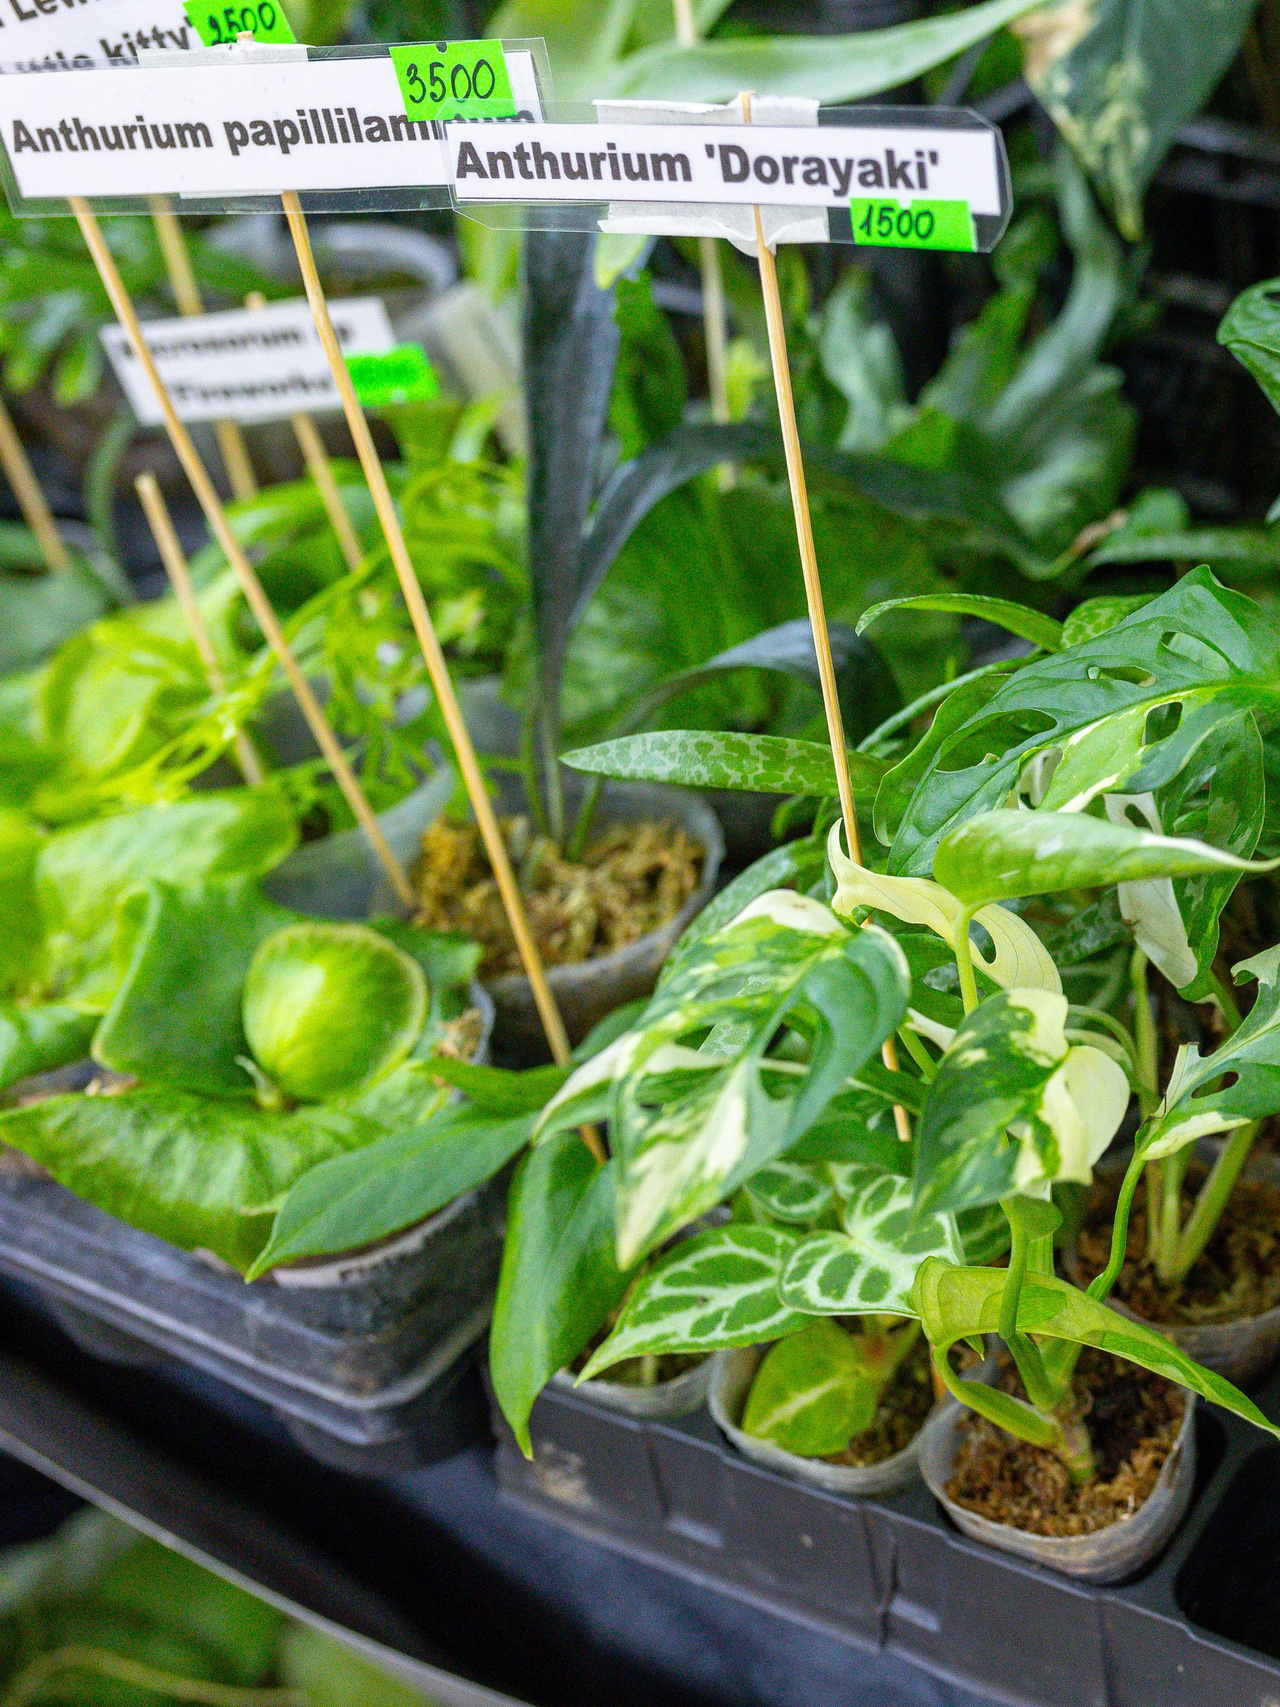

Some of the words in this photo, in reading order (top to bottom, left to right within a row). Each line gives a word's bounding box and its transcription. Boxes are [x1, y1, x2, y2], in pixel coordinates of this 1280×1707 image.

[406, 59, 496, 103] 3500
[13, 115, 213, 153] Anthurium
[456, 141, 692, 182] Anthurium
[704, 144, 938, 198] 'Dorayaki'
[859, 203, 935, 240] 1500
